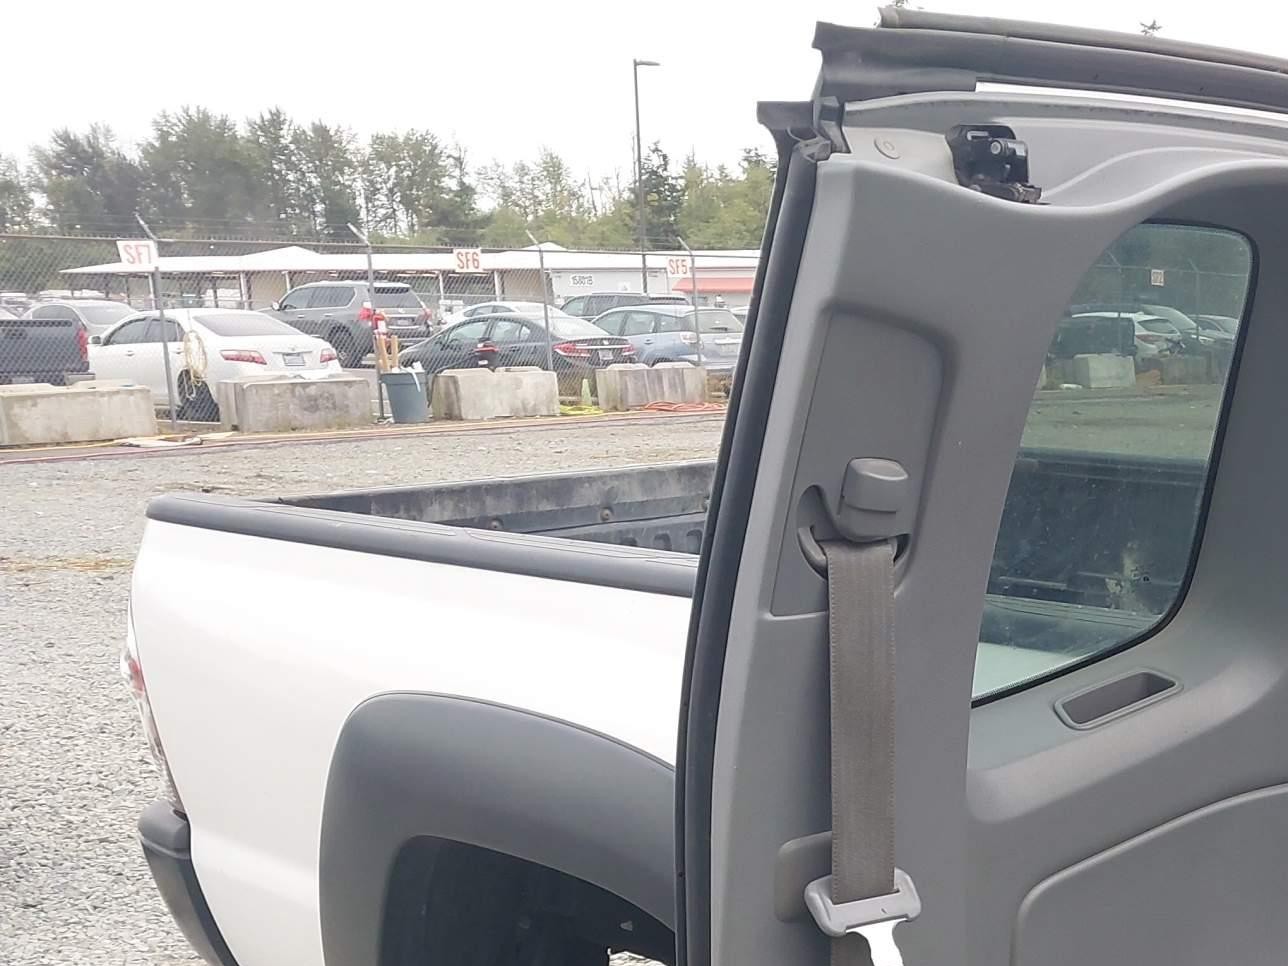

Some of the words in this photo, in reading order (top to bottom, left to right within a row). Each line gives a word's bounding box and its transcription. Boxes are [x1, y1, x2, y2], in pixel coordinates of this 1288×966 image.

[122, 244, 151, 265] SF7
[456, 251, 480, 270] SF6
[669, 258, 688, 275] SF5
